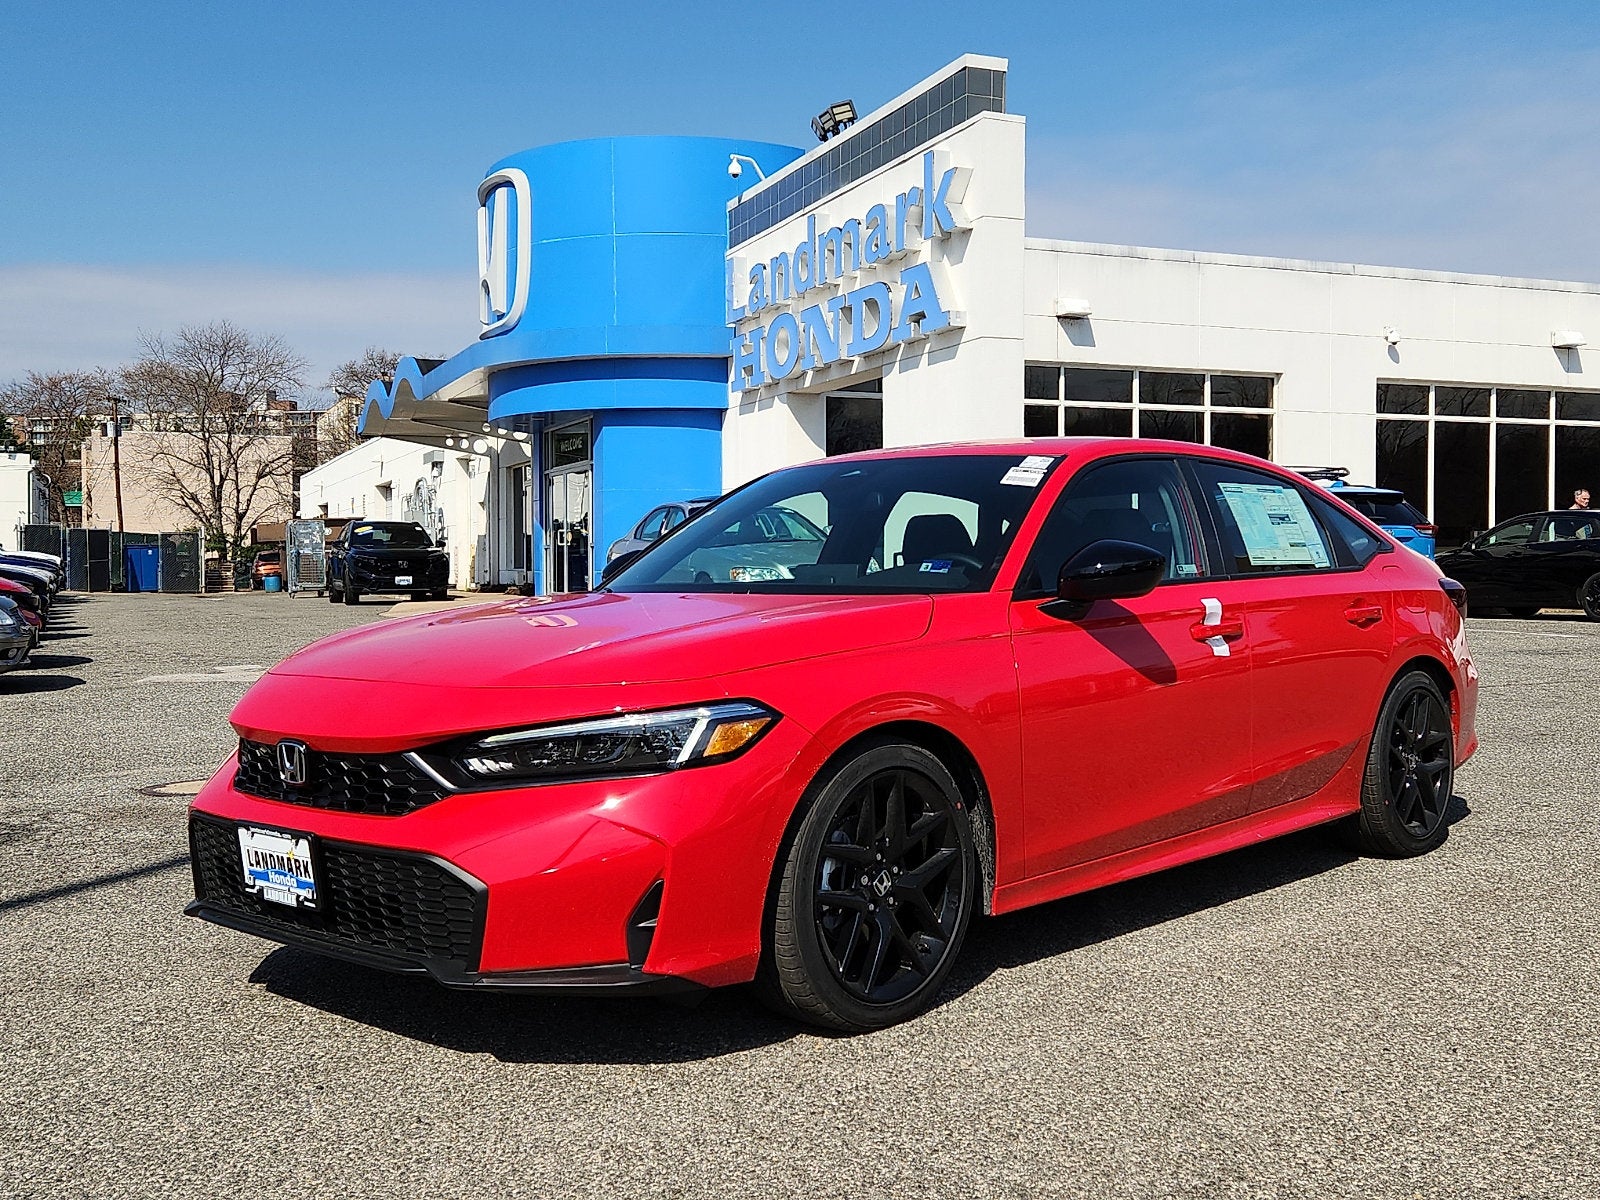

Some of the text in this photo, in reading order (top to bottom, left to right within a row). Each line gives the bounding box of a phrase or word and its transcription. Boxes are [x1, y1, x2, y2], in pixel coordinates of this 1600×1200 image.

[727, 150, 958, 325] Landmark
[731, 261, 950, 393] HONDA
[246, 848, 312, 880] LANDMARK
[268, 870, 297, 887] Honda
